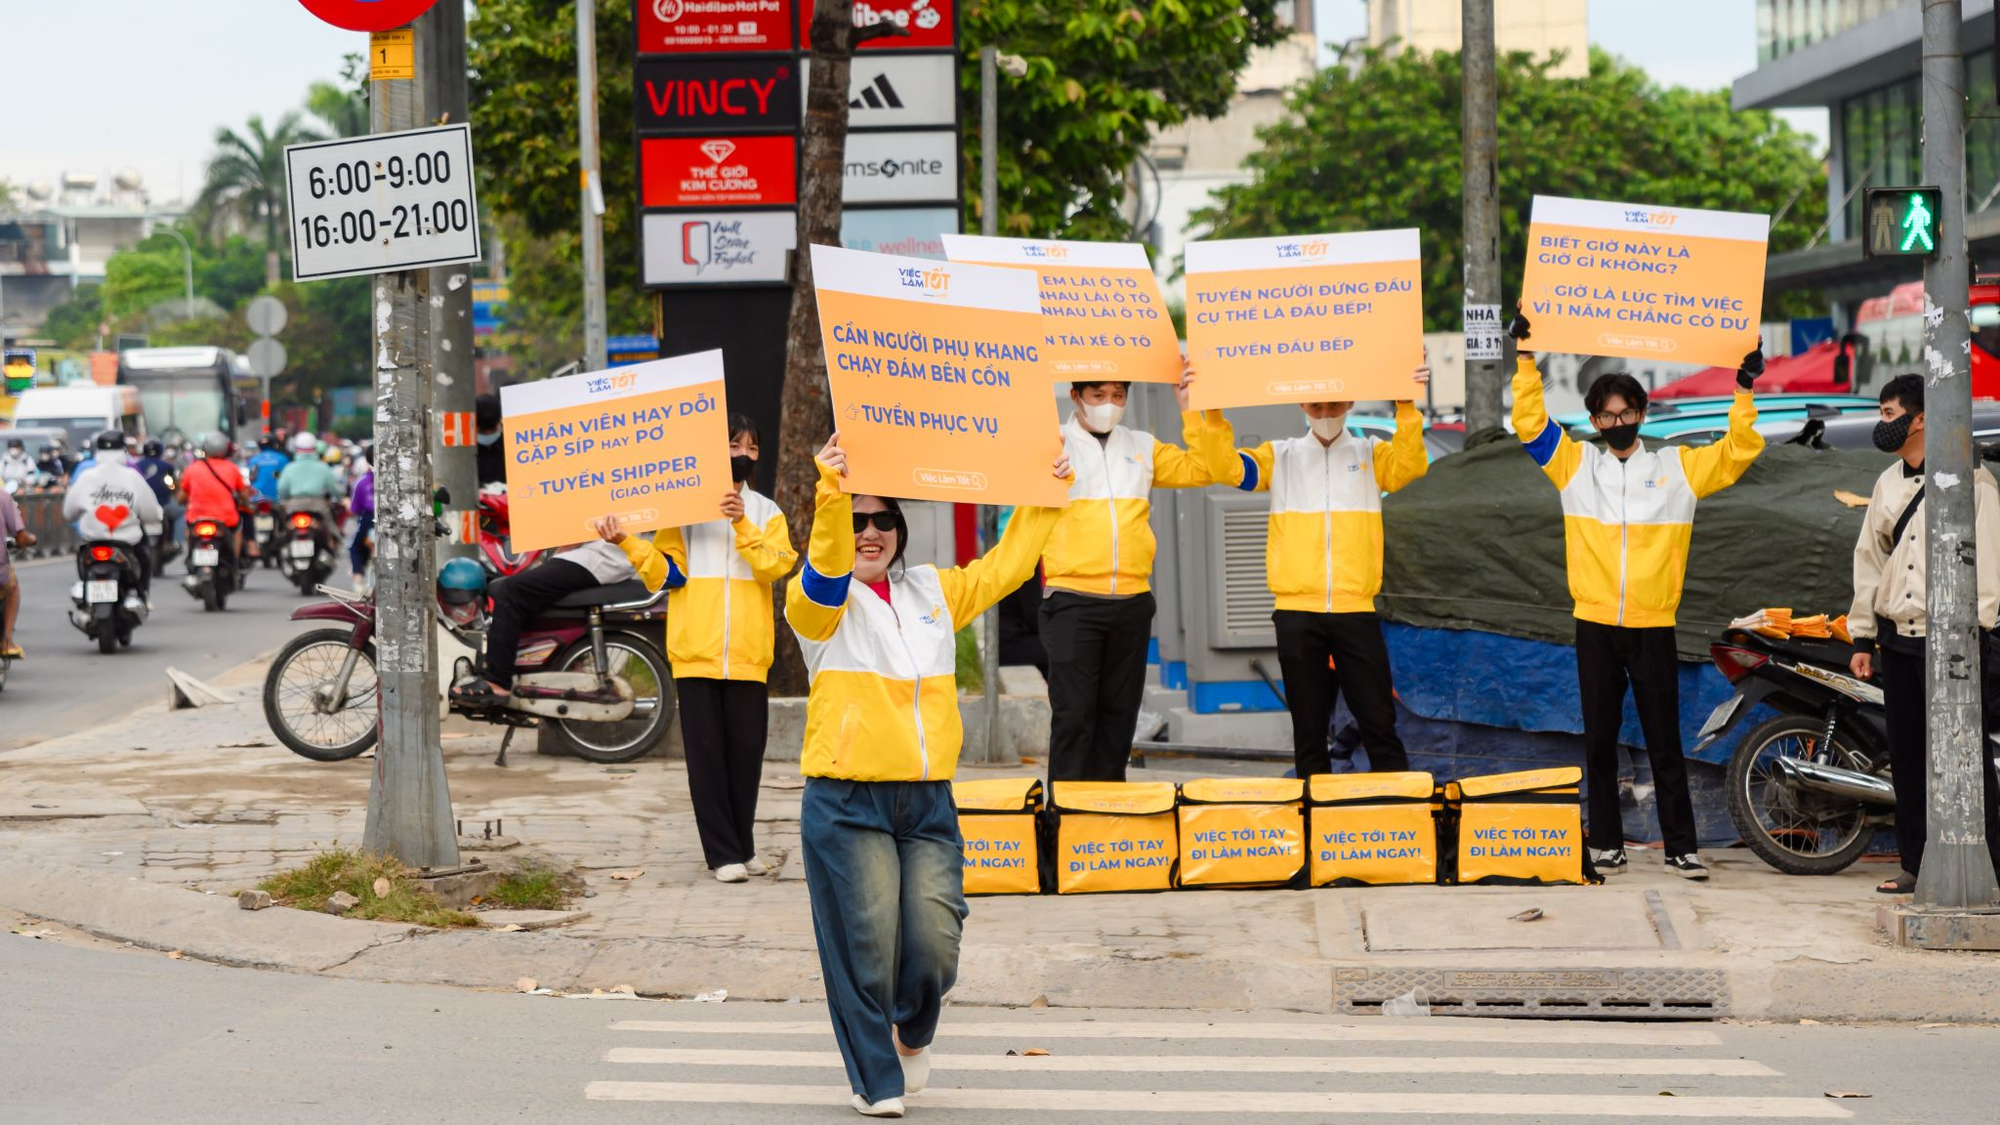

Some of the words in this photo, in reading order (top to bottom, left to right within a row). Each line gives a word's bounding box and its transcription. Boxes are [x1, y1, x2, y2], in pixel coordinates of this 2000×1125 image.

[684, 1, 735, 13] Haidilao
[380, 48, 386, 64] 1
[644, 77, 776, 116] VINCY
[309, 150, 451, 199] 6:00-9:00
[680, 180, 706, 191] KIM
[301, 198, 468, 249] 16:00-21:00
[1540, 234, 1581, 249] BIẾT
[1586, 239, 1620, 253] GIỜ
[1624, 242, 1662, 256] NÀY
[1668, 245, 1690, 259] LÀ
[1538, 252, 1572, 265] GIỜ
[1577, 254, 1594, 268] GÌ
[1600, 257, 1678, 274] KHÔNG?
[922, 266, 952, 290] TỐT
[1042, 275, 1066, 285] EM
[1100, 276, 1112, 288] Ô
[1115, 277, 1137, 288] TÔ
[1113, 291, 1125, 303] Ô
[1129, 292, 1150, 304] TÔ
[1257, 283, 1313, 300] NGƯỜI
[1318, 280, 1369, 296] ĐỨNG
[1554, 284, 1588, 298] GIỜ
[1593, 285, 1615, 300] LÀ
[1621, 288, 1657, 304] LÚC
[1663, 292, 1695, 307] TÌM
[1701, 295, 1743, 313] VIỆC
[1041, 306, 1086, 317] NHAU
[1120, 307, 1132, 318] Ô
[1136, 307, 1158, 319] TÔ
[1196, 312, 1220, 324] CỤ
[1263, 304, 1285, 319] LÀ
[1532, 300, 1550, 313] VÌ
[1556, 303, 1562, 314] 1
[1568, 302, 1610, 319] NĂM
[1688, 313, 1715, 328] CÓ
[1720, 317, 1749, 331] DƯ
[833, 321, 869, 346] CẦN
[873, 330, 928, 353] NGƯỜI
[933, 337, 969, 361] PHỤ
[975, 342, 1038, 362] KHANG
[1113, 334, 1125, 347] Ô
[1129, 335, 1151, 347] TÔ
[1486, 337, 1492, 349] 3
[837, 353, 882, 377] CHẠY
[887, 357, 926, 380] ĐÁM
[931, 361, 967, 384] BÊN
[972, 364, 1011, 387] CỒN
[515, 422, 573, 445] NHÂN
[579, 412, 626, 434] VIÊN
[632, 405, 673, 425] HAY
[679, 392, 716, 417] DỖI
[861, 402, 915, 428] TUYỂN
[920, 412, 968, 435] PHỤC
[972, 417, 998, 438] VỤ
[516, 442, 558, 465] GẶP
[564, 435, 595, 456] SÍP
[601, 436, 629, 450] HAY
[636, 424, 664, 443] PƠ
[539, 468, 605, 495] TUYỂN
[611, 456, 697, 483] SHIPPER
[938, 474, 956, 483] Làm
[610, 483, 651, 501] (GIAO
[655, 474, 702, 492] HÀNG)
[1194, 829, 1227, 843] VIỆC
[1232, 828, 1256, 841] TỚI
[1260, 828, 1286, 840] TAY
[1323, 830, 1357, 845] VIỆC
[1361, 829, 1385, 843] TỚI
[1389, 830, 1417, 841] TAY
[1473, 828, 1507, 841] VIỆC
[1512, 826, 1536, 840] TỚI
[1541, 829, 1567, 840] TAY
[966, 838, 989, 851] TỚI
[994, 841, 1020, 851] TAY
[1072, 841, 1105, 855] VIỆC
[1109, 839, 1135, 853] TỚI
[1138, 839, 1165, 851] TAY
[1191, 849, 1208, 860] ĐI
[1211, 844, 1243, 859] LÀM
[1247, 845, 1291, 857] NGAY!
[1469, 846, 1487, 857] ĐI
[1490, 843, 1522, 857] LÀM
[1526, 846, 1571, 857] NGAY!
[1320, 850, 1336, 861] ĐI
[1340, 846, 1372, 860] LÀM
[1376, 847, 1421, 859] NGAY!
[981, 857, 1025, 868] NGAY!
[1069, 861, 1086, 873] ĐI
[1090, 856, 1121, 870] LÀM
[1125, 856, 1169, 868] NGAY!
